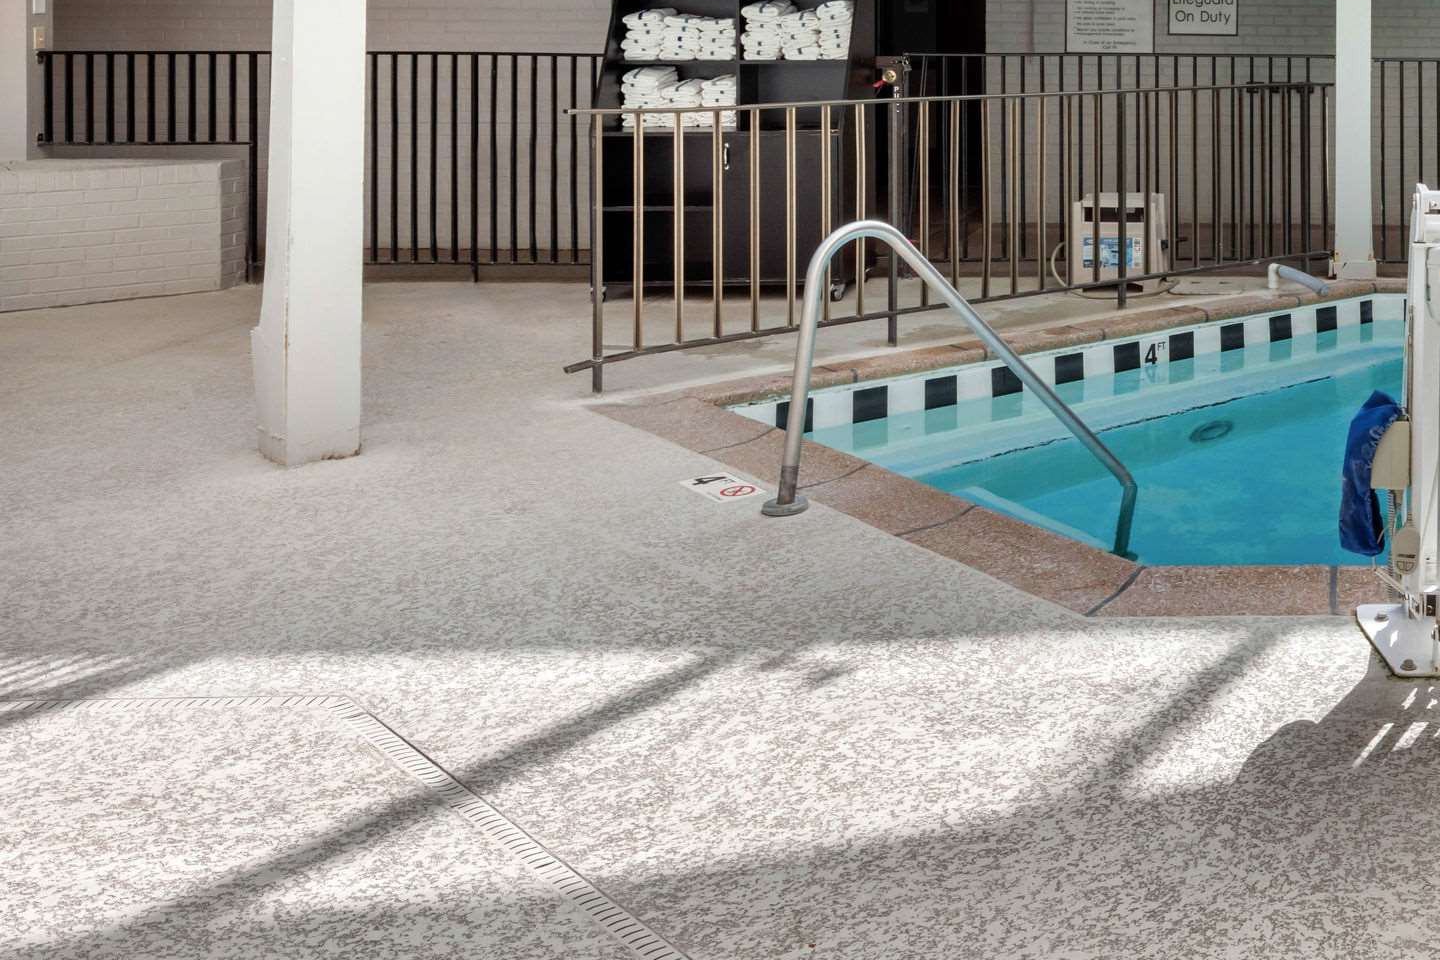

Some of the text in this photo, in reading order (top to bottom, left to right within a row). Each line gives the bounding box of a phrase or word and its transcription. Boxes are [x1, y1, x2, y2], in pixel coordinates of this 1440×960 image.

[1175, 10, 1232, 25] On Duty
[1145, 341, 1166, 365] 4 FT
[692, 476, 726, 486] 4
